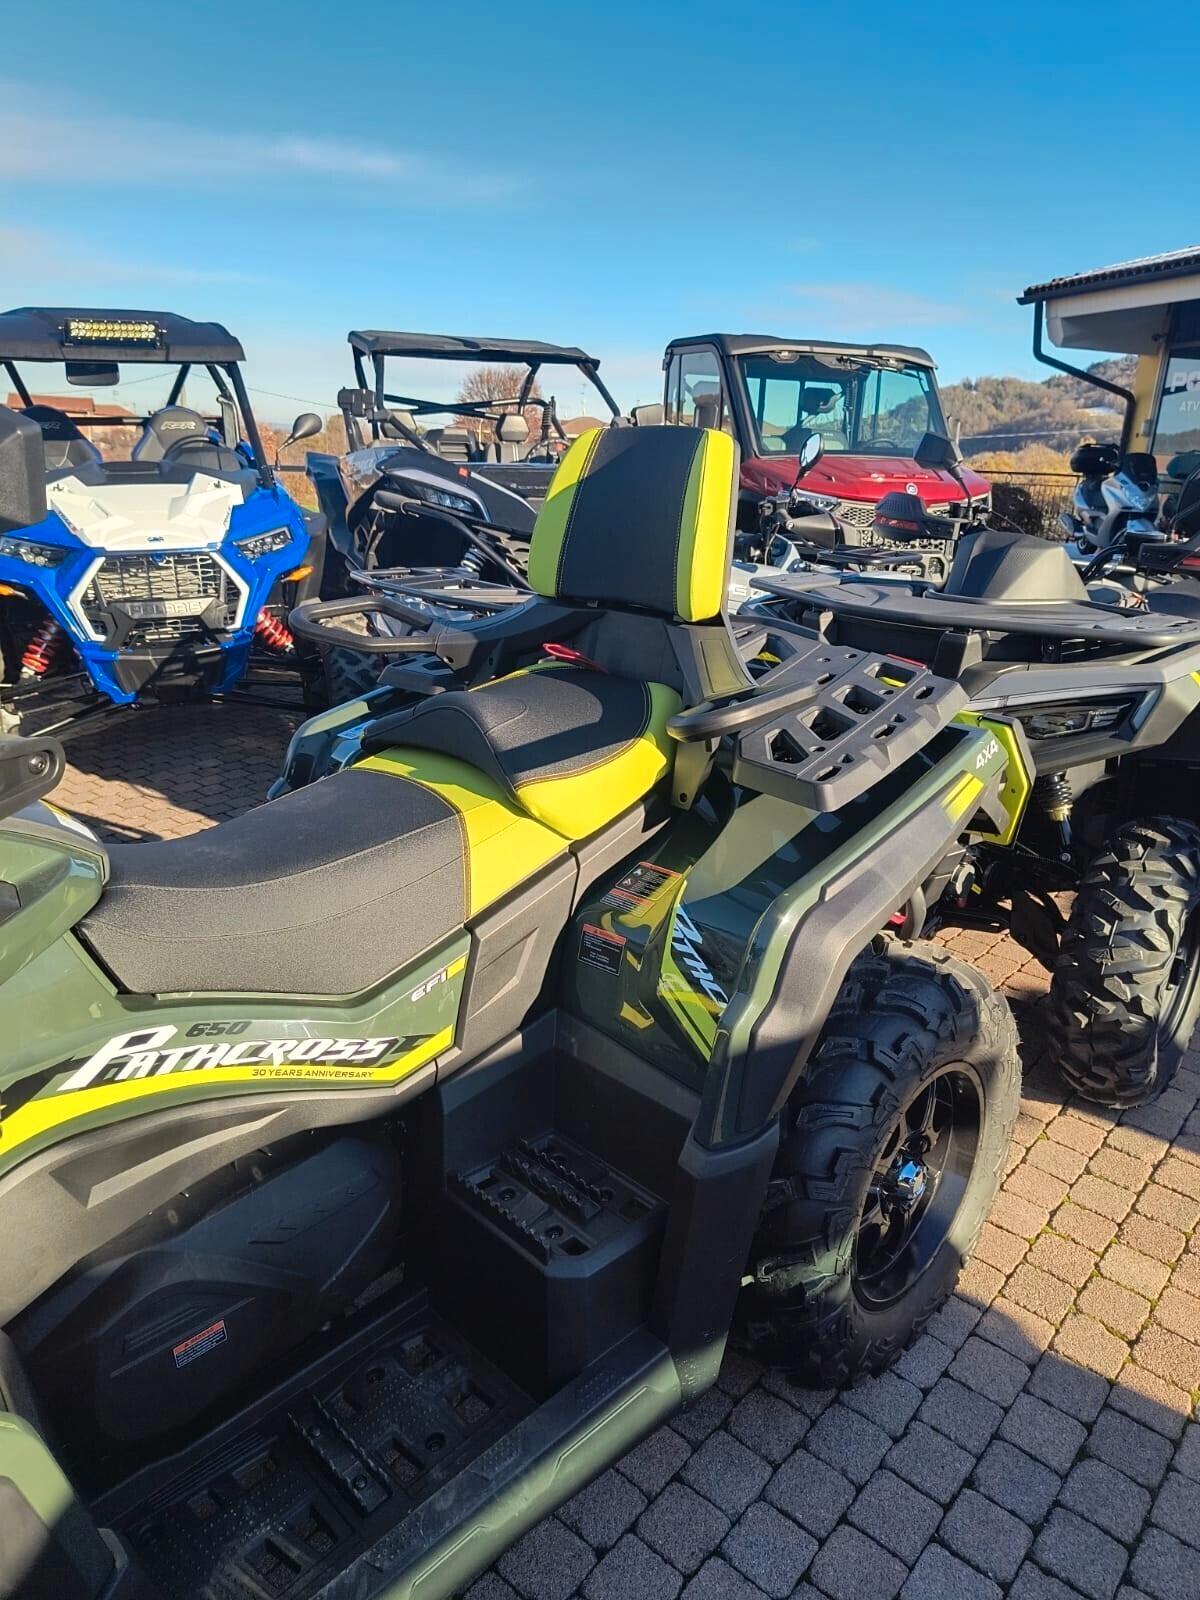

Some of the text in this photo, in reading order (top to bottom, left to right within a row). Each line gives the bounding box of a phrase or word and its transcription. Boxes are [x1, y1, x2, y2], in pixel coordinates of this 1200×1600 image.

[128, 602, 201, 618] POLARIS
[411, 969, 447, 1002] EFI
[185, 1021, 251, 1038] 650
[56, 1024, 400, 1091] PATHCROSS
[252, 1069, 375, 1079] 30 YEARS ANNIVERSARY
